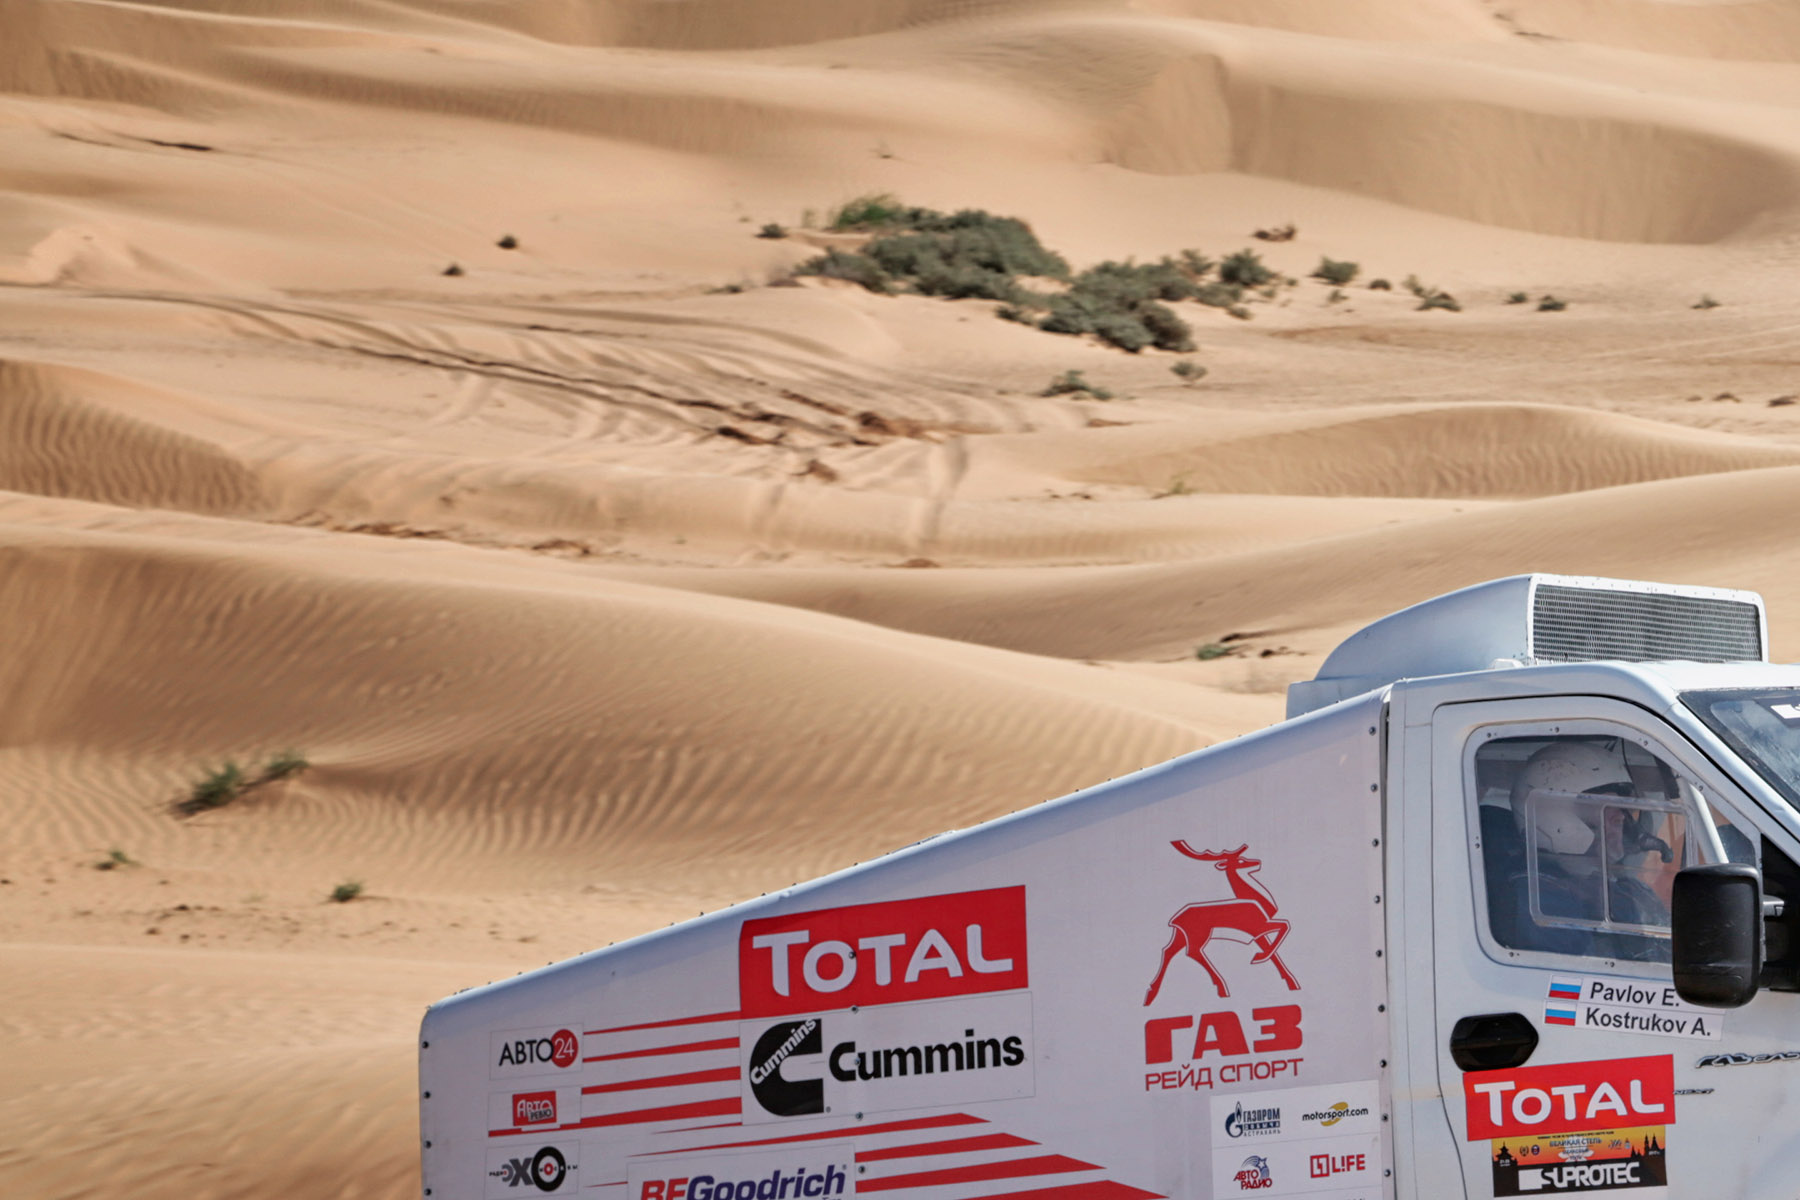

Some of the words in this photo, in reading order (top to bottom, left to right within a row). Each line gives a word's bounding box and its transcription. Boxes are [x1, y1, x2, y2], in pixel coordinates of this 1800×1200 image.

[752, 923, 1014, 997] TOTAL
[1590, 981, 1657, 1004] Pavlov
[1661, 988, 1680, 1007] E.
[1144, 1004, 1303, 1065] ГАЗ
[1585, 1007, 1687, 1034] Kostrukov
[1690, 1017, 1711, 1037] A.
[750, 1019, 817, 1085] Cummins
[828, 1028, 1025, 1083] Cummins
[1145, 1063, 1213, 1092] РЕЙД
[1219, 1057, 1304, 1083] СПОРТ
[1243, 1108, 1281, 1123] ГАЗПРОМ
[1302, 1107, 1369, 1122] motorsport.com
[1473, 1079, 1665, 1127] TOTAL
[1233, 1169, 1260, 1182] АВТО
[1240, 1177, 1273, 1191] РАДИО
